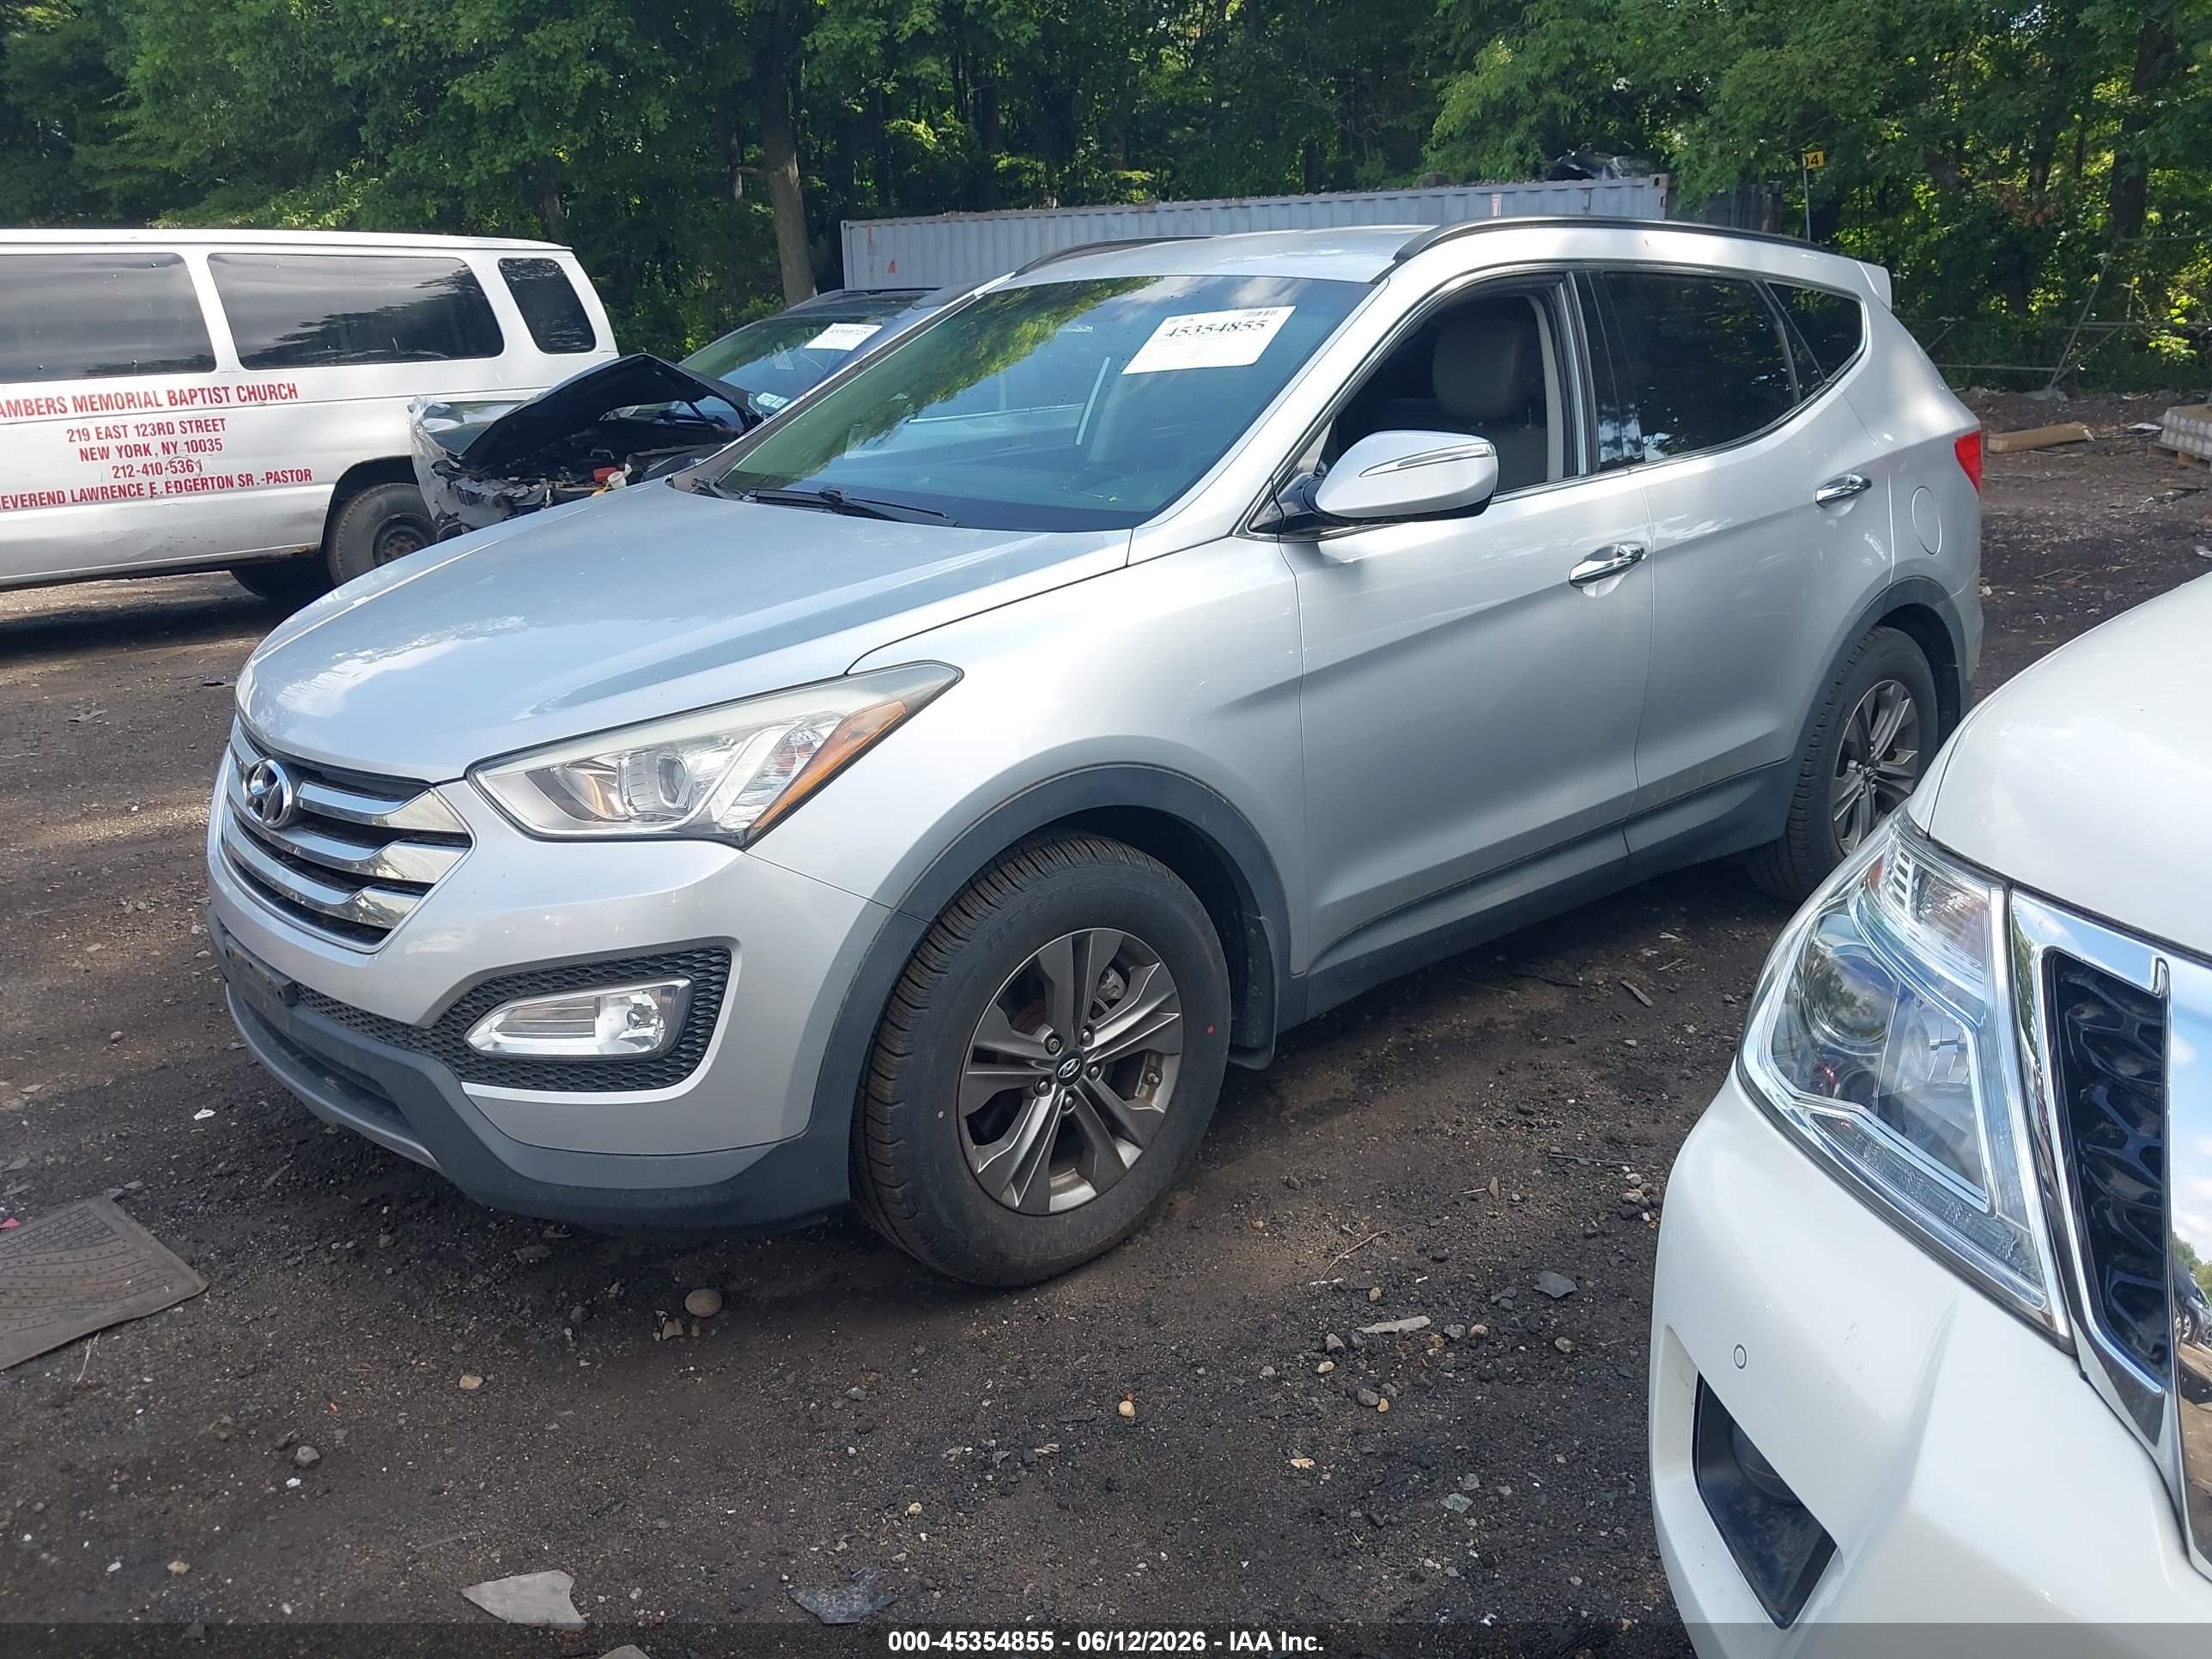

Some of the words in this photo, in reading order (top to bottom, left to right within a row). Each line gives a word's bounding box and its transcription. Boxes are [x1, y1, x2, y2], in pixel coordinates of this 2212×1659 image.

[1164, 319, 1268, 337] 45354855
[72, 391, 163, 413] MEMORIAL
[167, 386, 231, 407] BAPTIST
[236, 383, 299, 403] CHURCH
[66, 428, 90, 443] 219
[95, 425, 128, 441] EAST
[133, 422, 176, 439] 123RD
[179, 417, 227, 434] STREET
[79, 447, 111, 462] NEW
[117, 442, 160, 459] YORK,
[161, 441, 179, 455] NY
[185, 438, 223, 453] 10035
[112, 459, 204, 479] 212-410-5361
[0, 489, 67, 510] EVEREND
[70, 482, 145, 503] LAWRENCE
